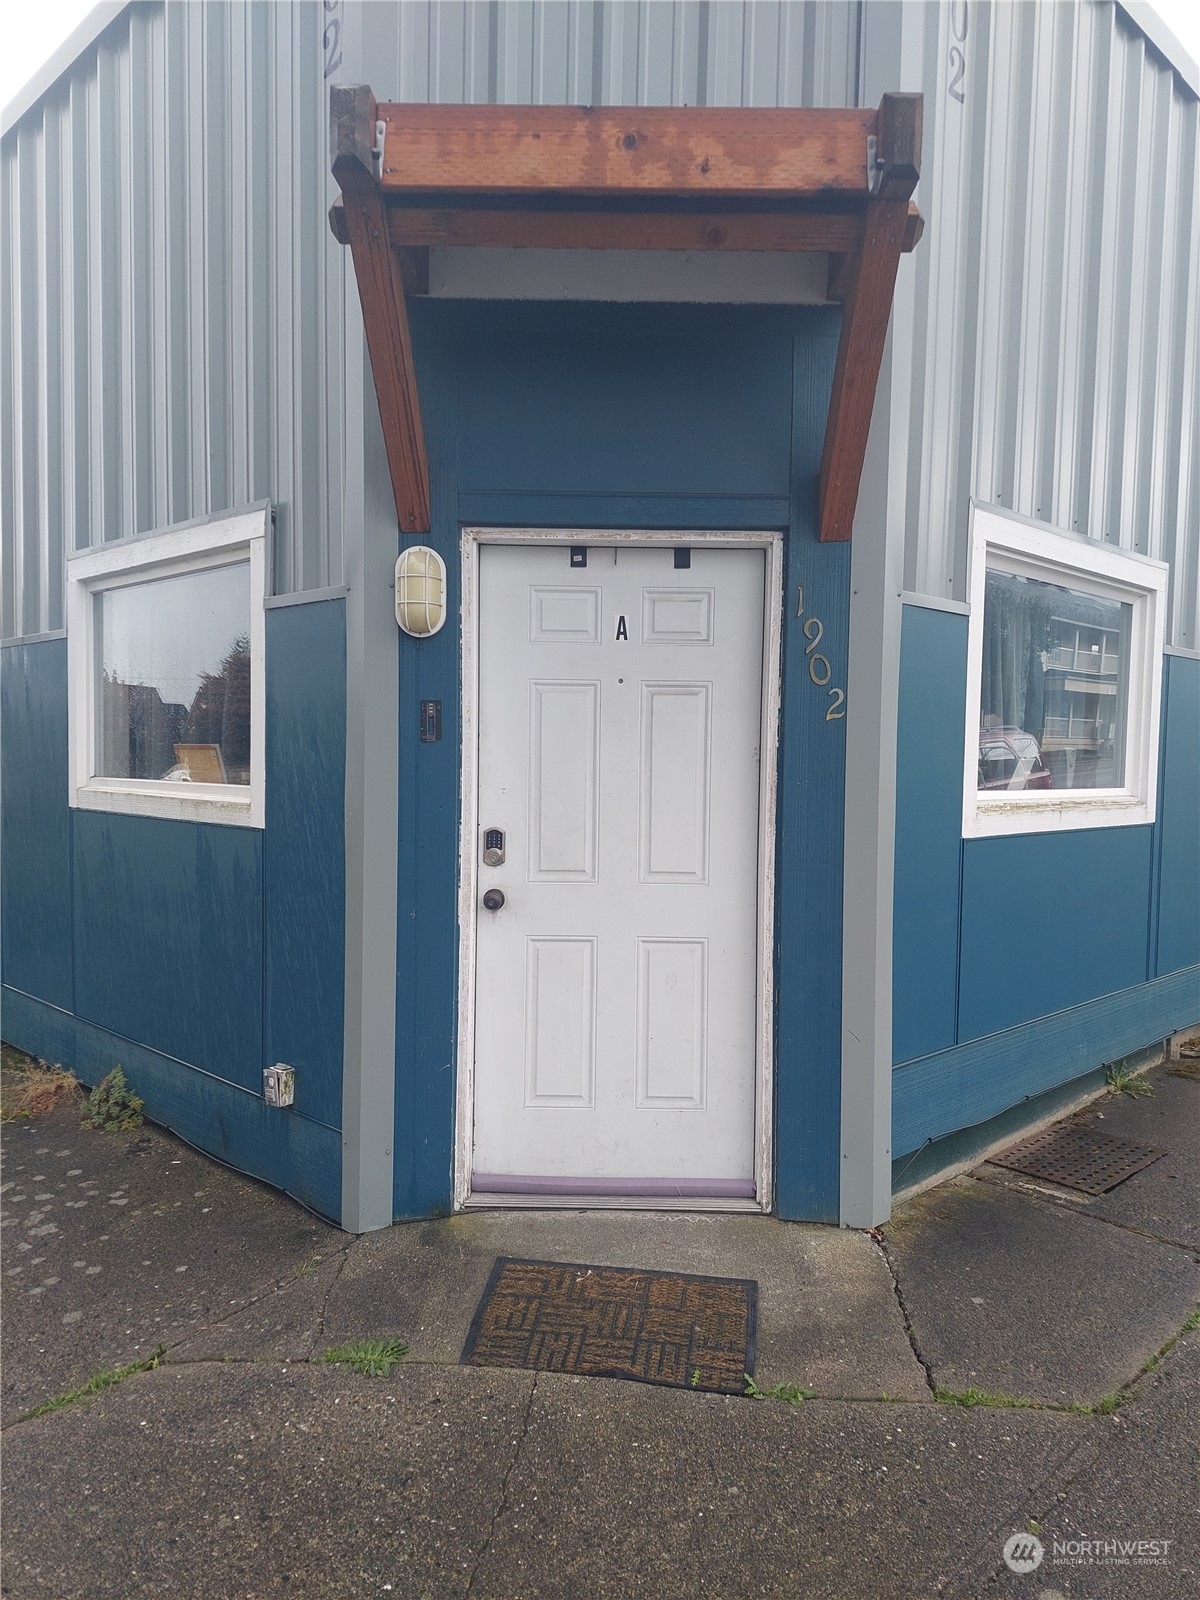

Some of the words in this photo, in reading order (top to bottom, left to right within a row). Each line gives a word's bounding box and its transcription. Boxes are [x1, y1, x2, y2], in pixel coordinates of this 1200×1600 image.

[323, 0, 342, 79] 2
[615, 615, 629, 641] A
[796, 585, 845, 721] 1902
